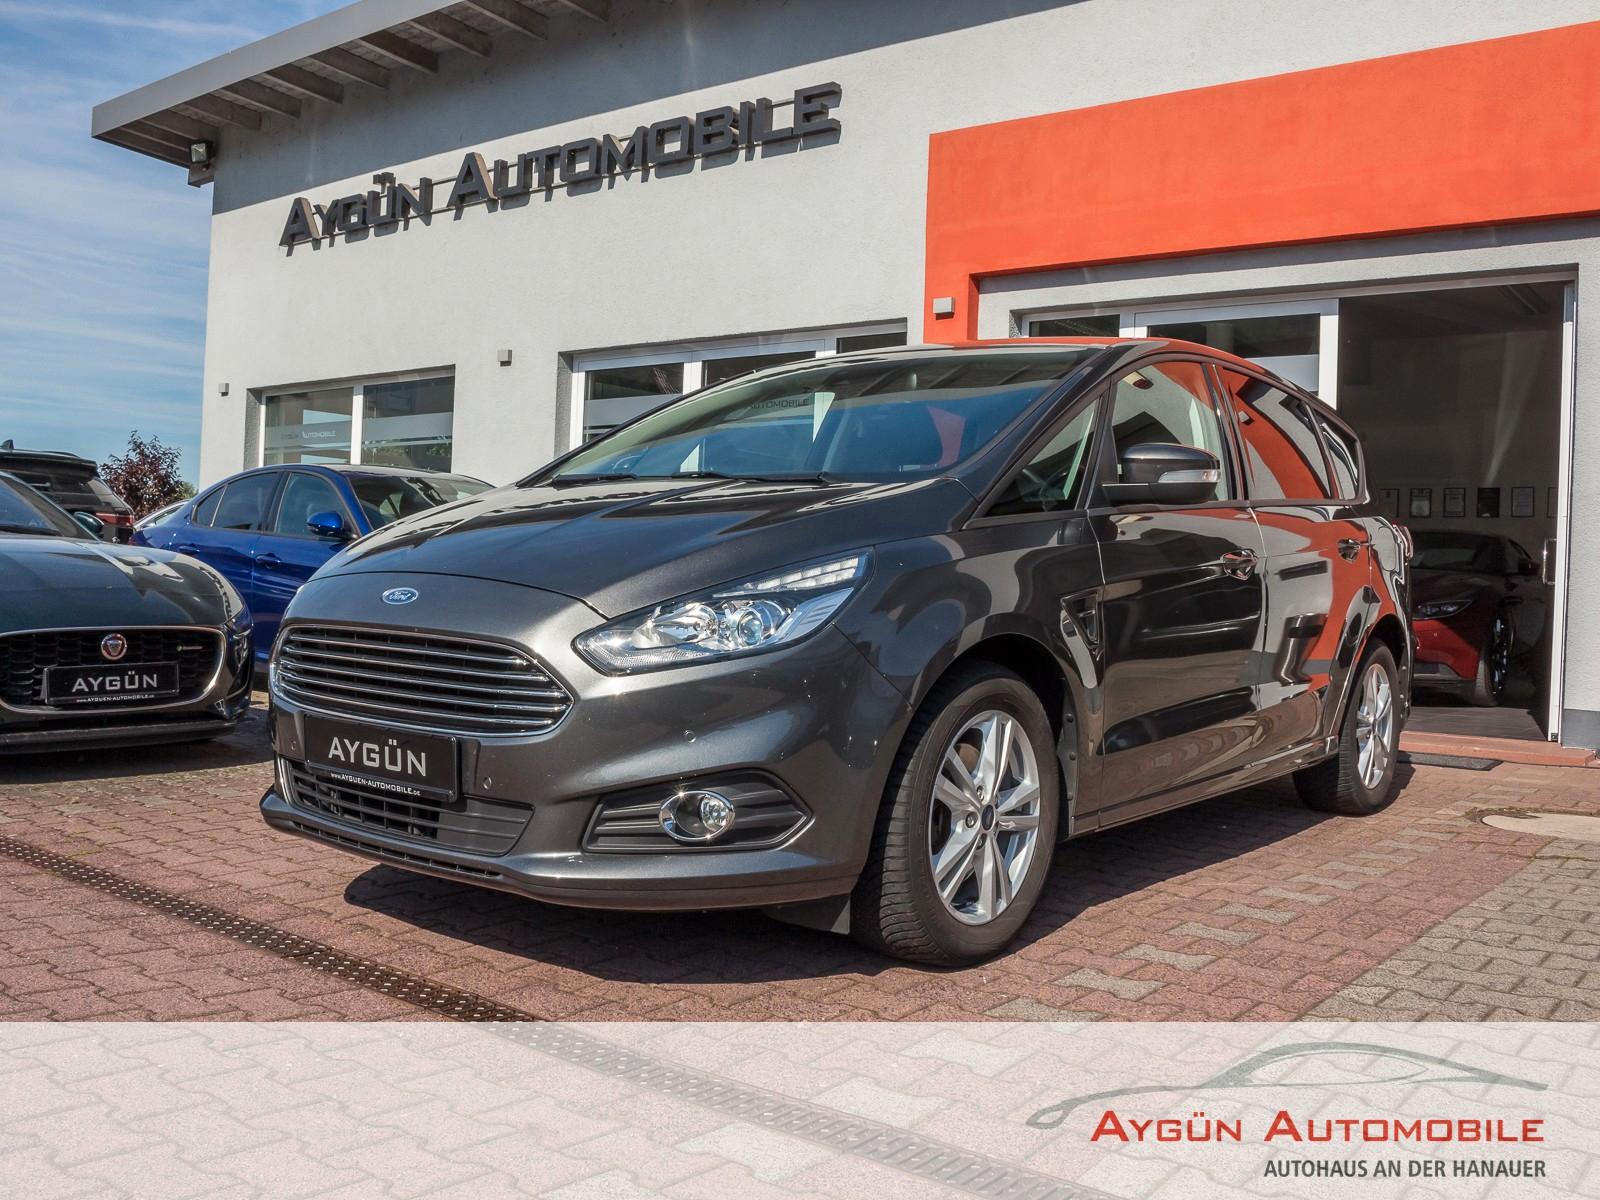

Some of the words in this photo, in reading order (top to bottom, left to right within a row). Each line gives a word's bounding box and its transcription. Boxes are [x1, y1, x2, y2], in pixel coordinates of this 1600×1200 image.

[279, 171, 433, 247] AYGÜN
[446, 81, 842, 208] AUTOMOBILE
[72, 670, 158, 693] AYGÜN
[328, 736, 427, 777] AYGÜN
